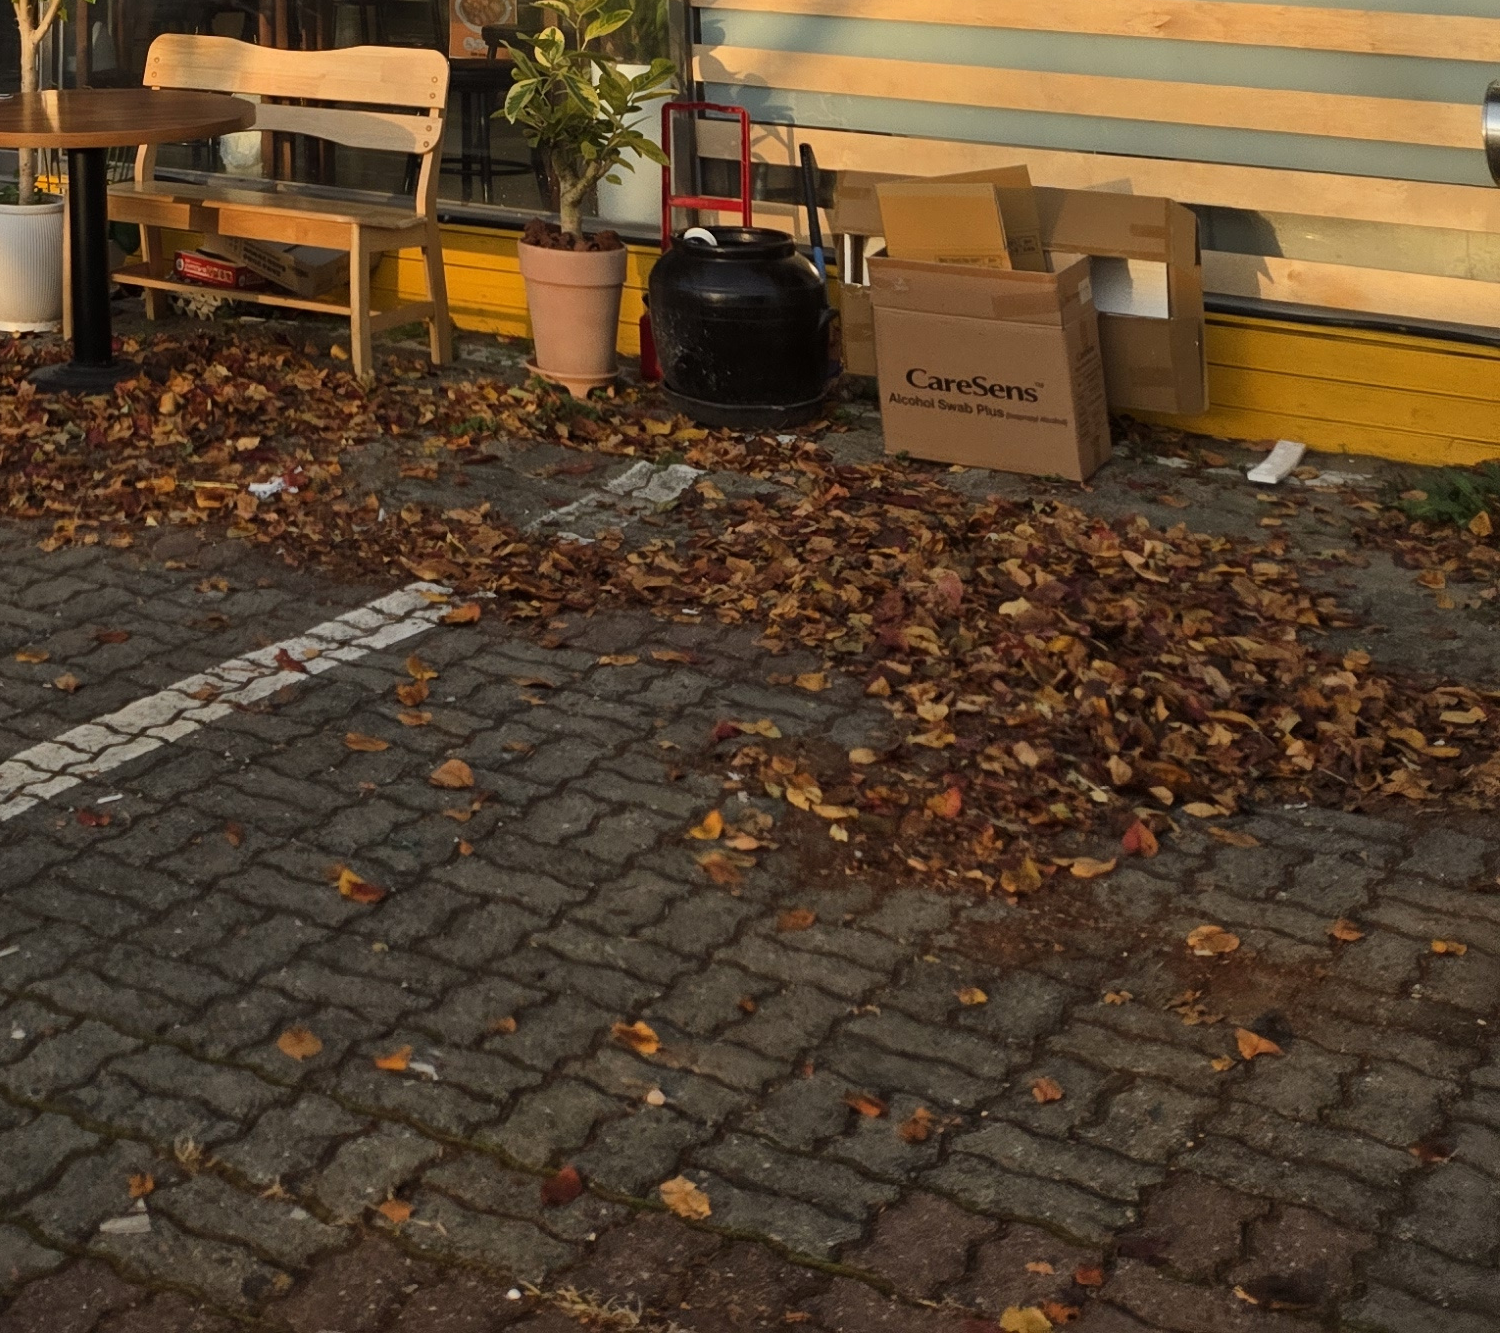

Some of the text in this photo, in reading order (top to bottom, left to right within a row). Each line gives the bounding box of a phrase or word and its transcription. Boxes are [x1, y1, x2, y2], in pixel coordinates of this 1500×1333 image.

[889, 392, 1005, 419] Alcohol Swab Plus
